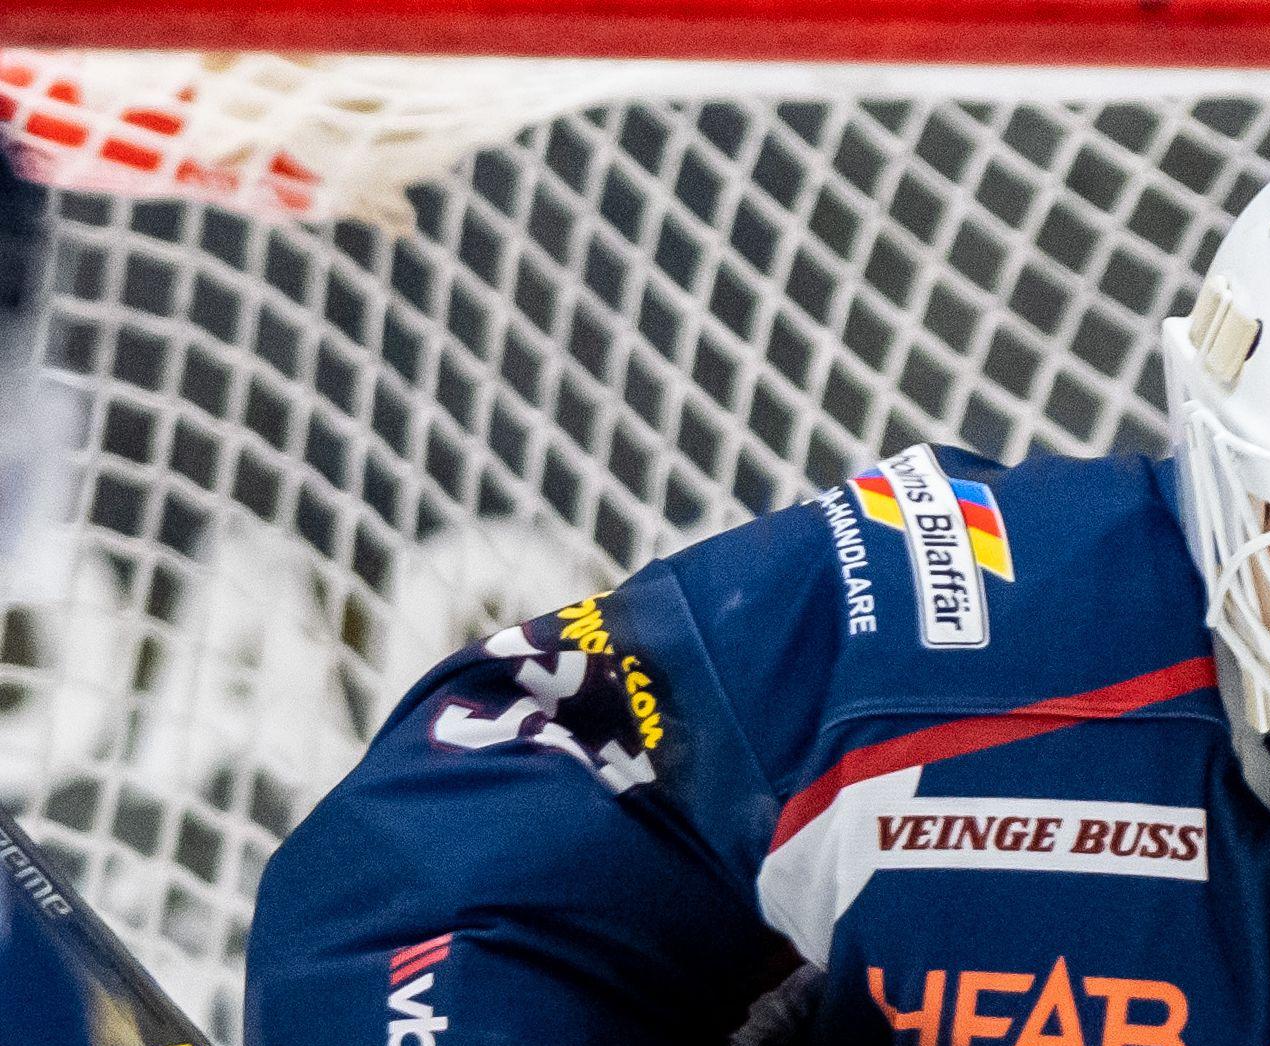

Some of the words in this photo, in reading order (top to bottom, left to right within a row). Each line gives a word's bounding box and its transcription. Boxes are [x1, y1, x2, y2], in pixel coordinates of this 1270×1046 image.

[817, 485, 878, 637] A-HANDLARE
[914, 513, 971, 632] Bilaffär
[877, 814, 1063, 853] VEINGE
[1069, 818, 1206, 862] BUSS
